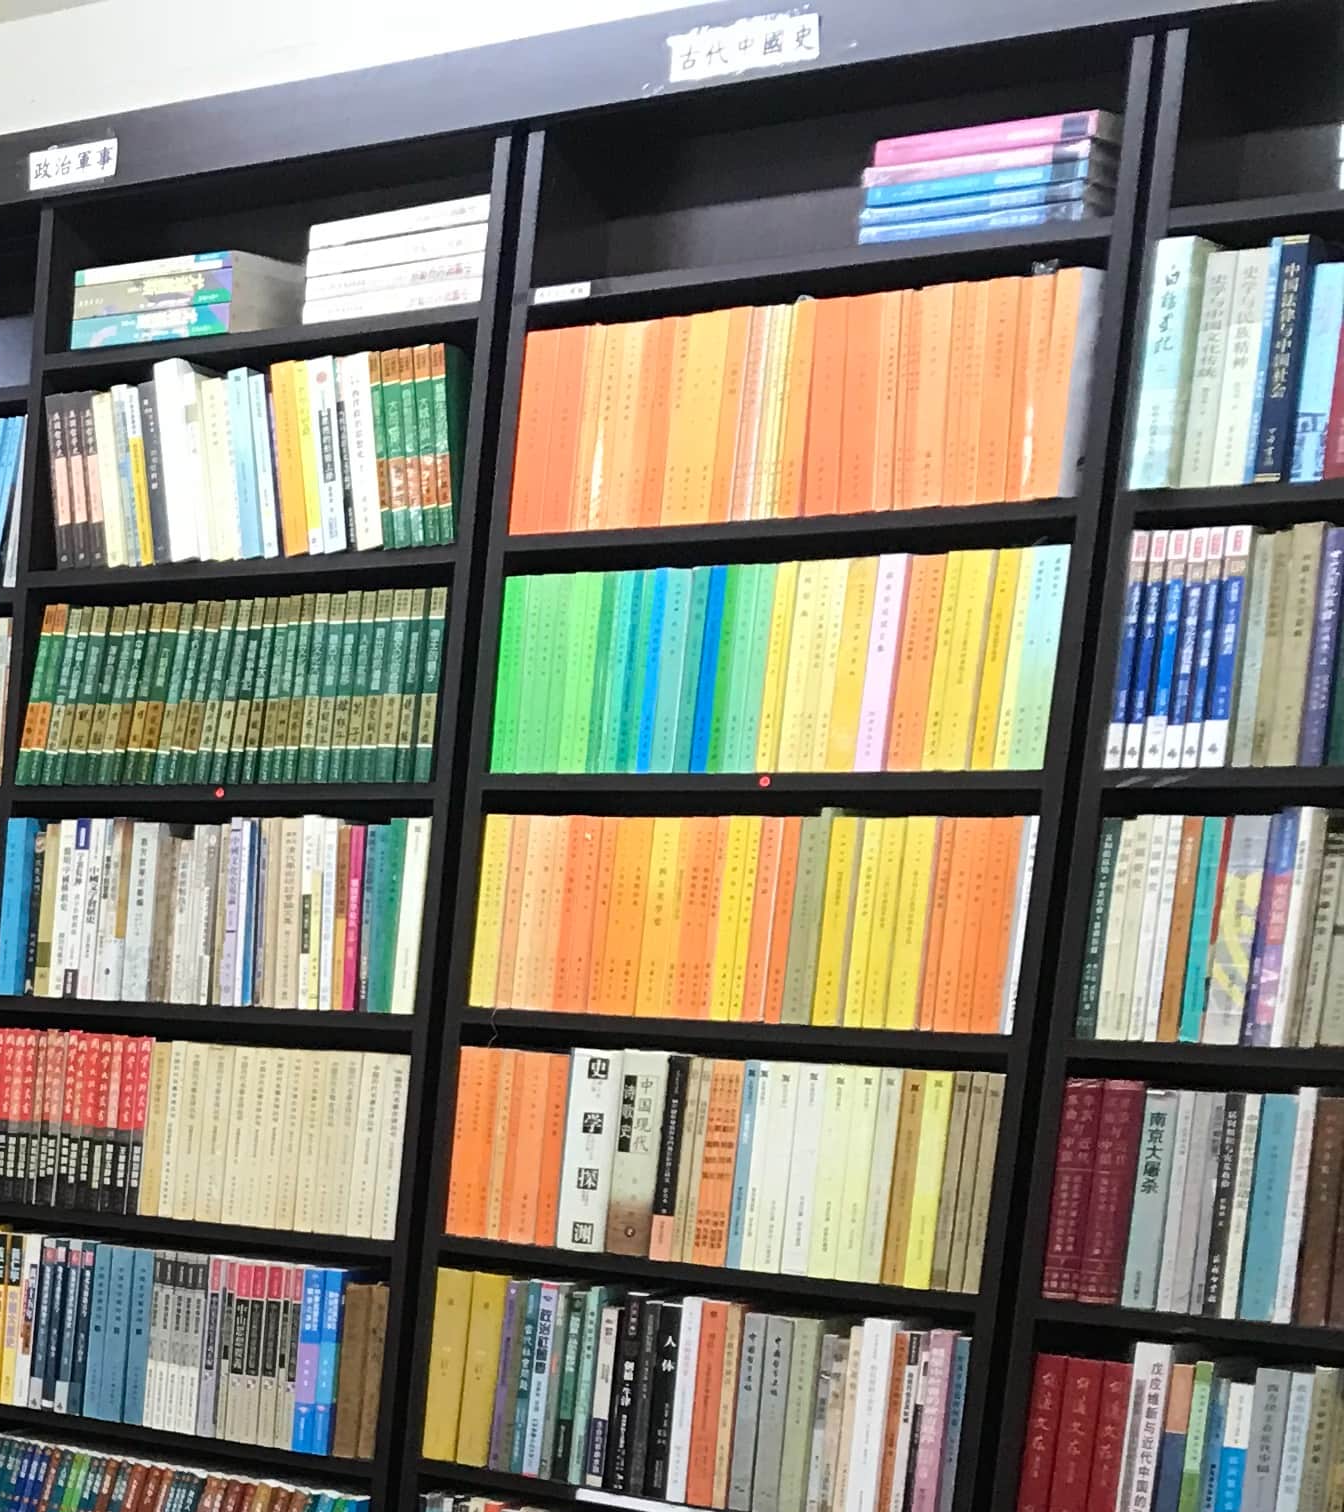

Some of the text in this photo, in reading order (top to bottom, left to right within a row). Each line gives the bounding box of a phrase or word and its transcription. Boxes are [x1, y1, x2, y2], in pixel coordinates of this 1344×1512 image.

[680, 24, 815, 70] 古代中國史
[33, 146, 114, 179] 政治軍事
[632, 1078, 653, 1153] 中国现代
[1141, 1111, 1168, 1195] 南京大屠杀
